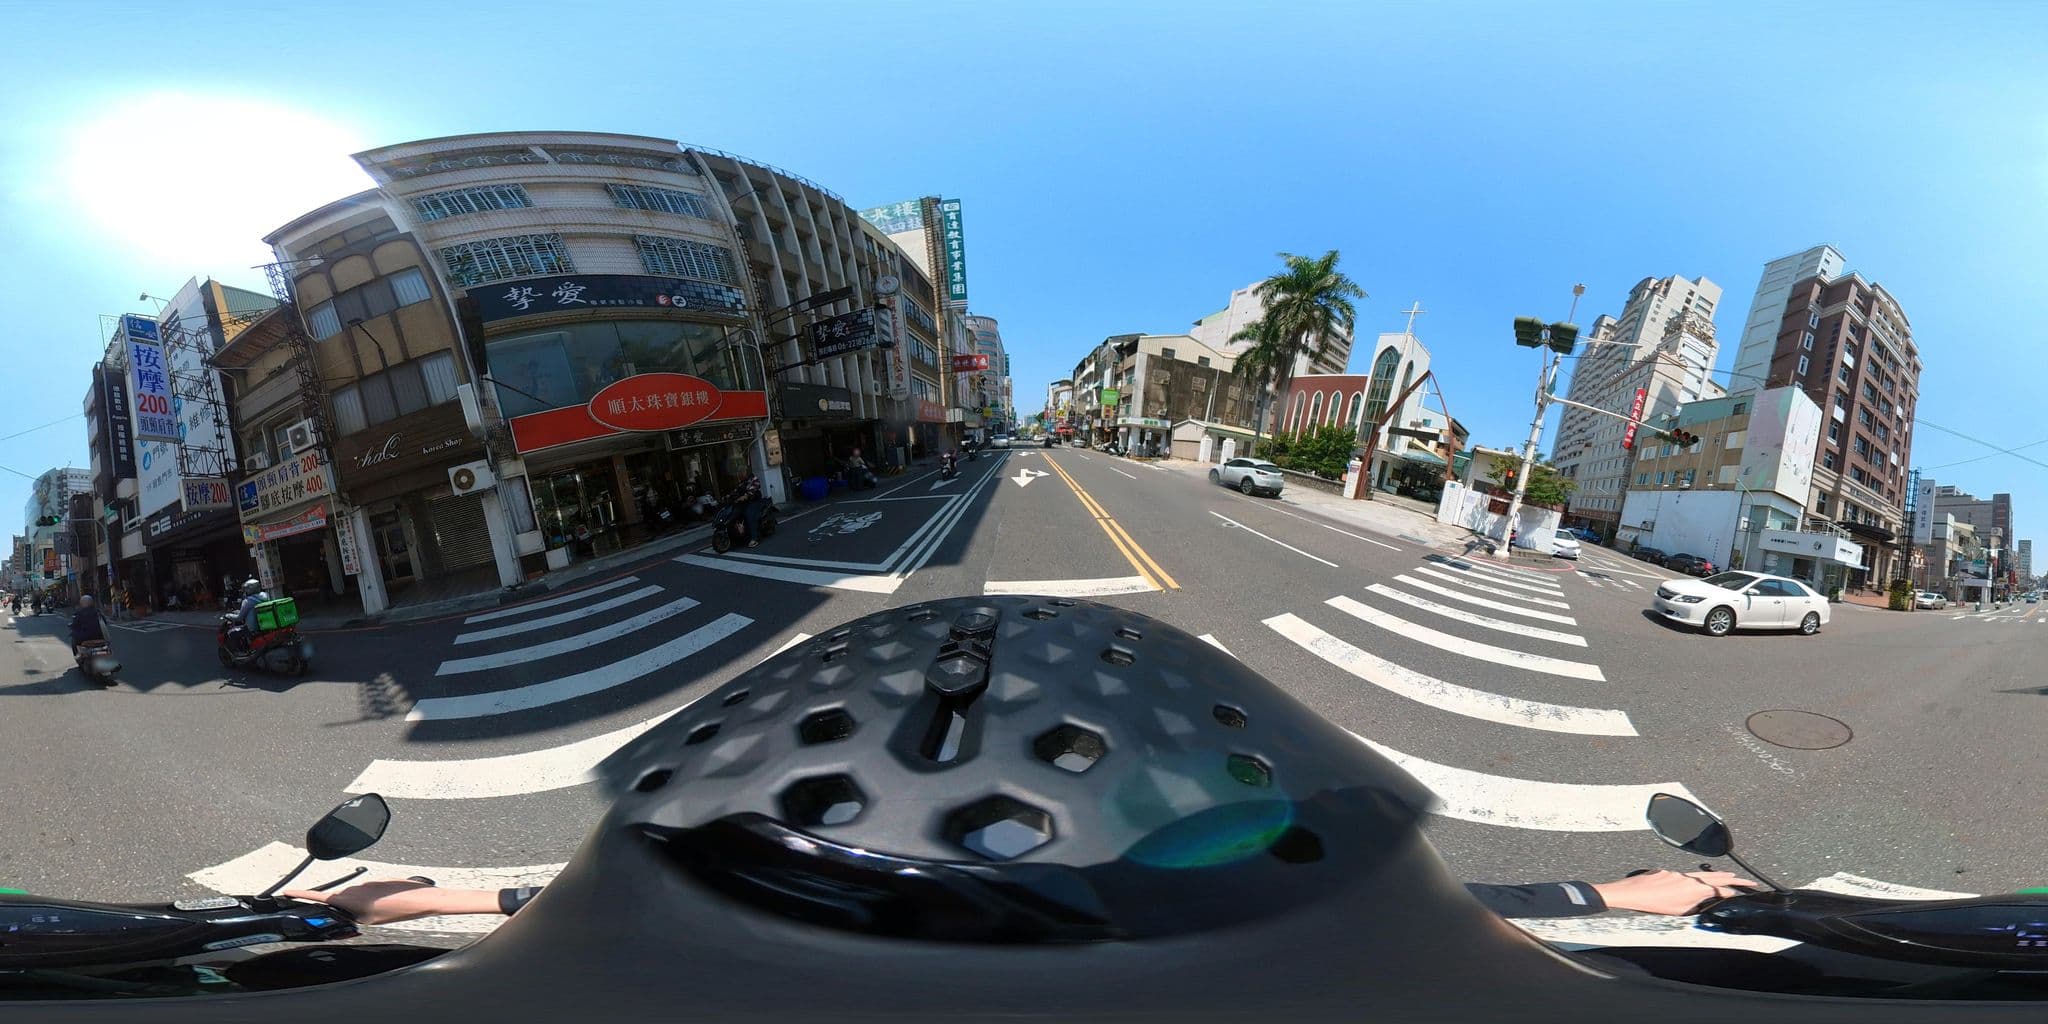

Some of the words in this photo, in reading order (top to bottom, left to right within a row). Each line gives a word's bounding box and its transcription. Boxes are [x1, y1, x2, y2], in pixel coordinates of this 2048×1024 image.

[134, 345, 165, 393] 按摩
[137, 393, 168, 415] 200
[607, 390, 711, 415] 順太珠寶銀樓
[444, 438, 463, 449] Shop
[301, 453, 318, 474] 200
[186, 482, 210, 506] 按摩
[209, 482, 229, 504] 200
[306, 475, 323, 494] 400
